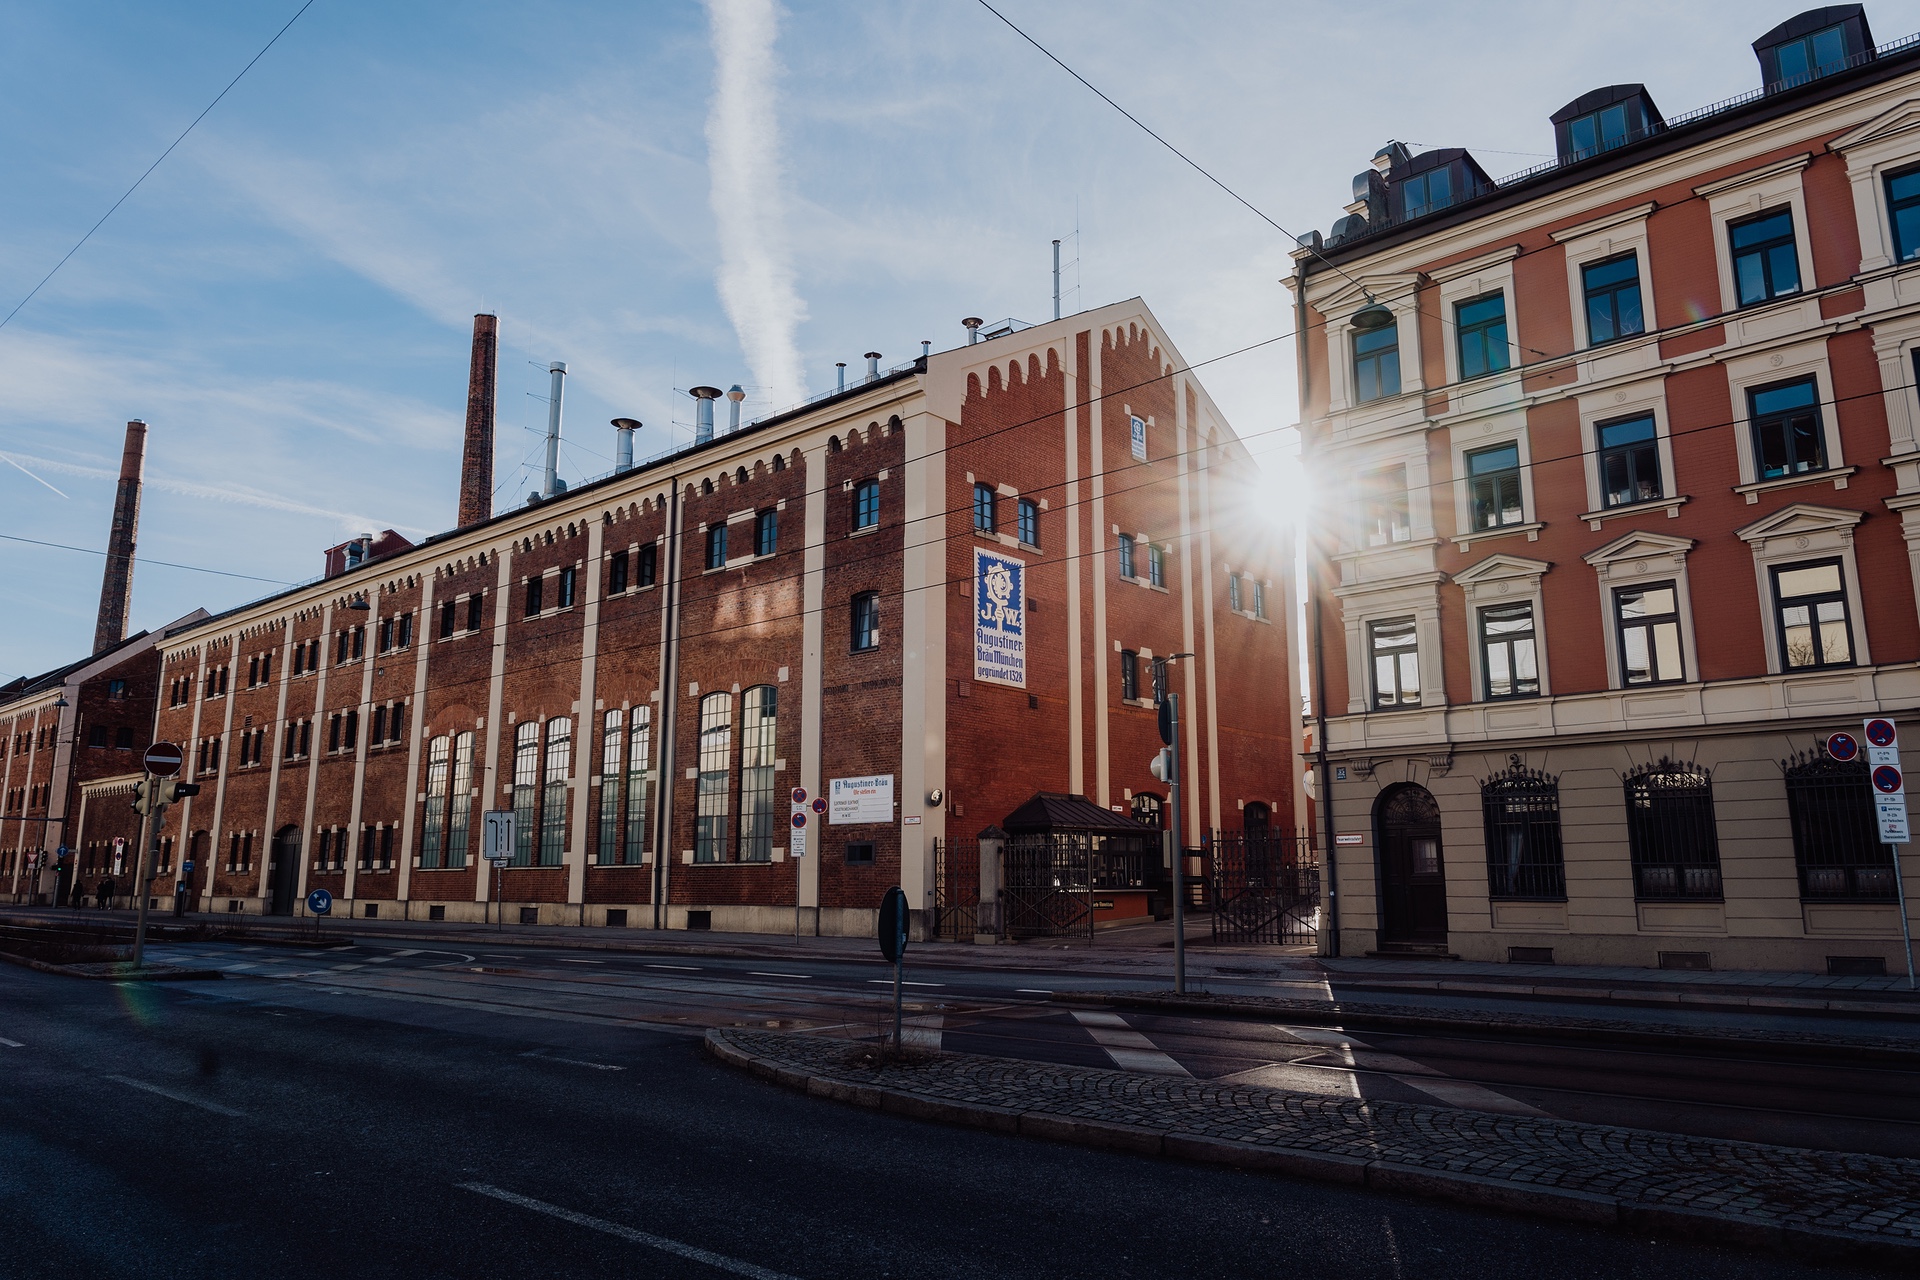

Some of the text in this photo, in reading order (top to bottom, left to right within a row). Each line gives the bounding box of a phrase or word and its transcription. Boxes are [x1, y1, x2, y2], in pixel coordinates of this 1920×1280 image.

[976, 645, 1024, 669] Bräu München
[977, 666, 1023, 683] gegründet 1328
